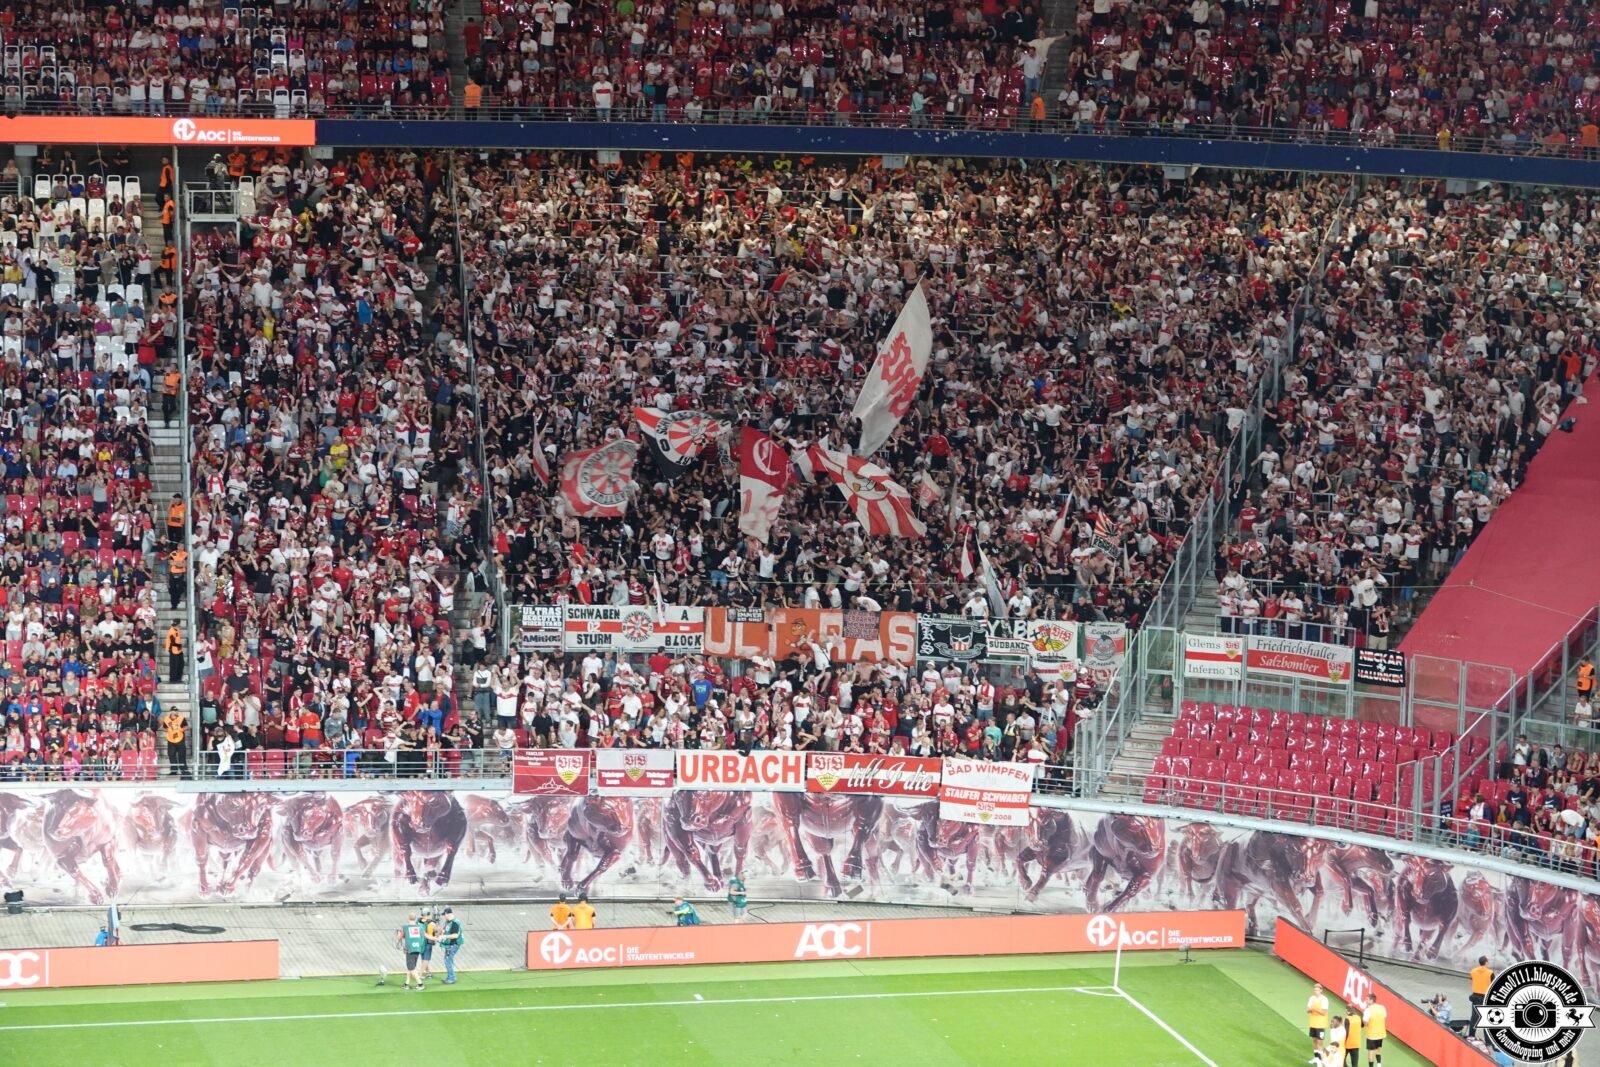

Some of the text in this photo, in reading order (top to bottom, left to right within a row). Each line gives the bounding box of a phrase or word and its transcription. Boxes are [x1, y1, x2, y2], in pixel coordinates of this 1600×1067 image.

[197, 130, 226, 141] AOC
[522, 606, 562, 616] ULTRAS
[568, 608, 689, 621] SCHWABEN A
[587, 622, 601, 632] 02
[576, 633, 702, 647] STURM BLOCK
[989, 640, 1030, 651] SÜDBANDE
[1188, 639, 1221, 649] Glems
[1256, 639, 1337, 661] Friedrichshaller
[1260, 655, 1320, 673] Salzbomber
[1359, 650, 1403, 666] NECKAR
[1188, 664, 1225, 674] Inferno
[1357, 669, 1404, 683] HALUNKEN
[680, 755, 801, 784] URBACH
[847, 757, 886, 788] till
[903, 763, 934, 792] die
[948, 764, 1030, 782] BAD WIMPFEN
[945, 789, 1028, 804] STAUFER SCHWABEN
[795, 923, 862, 957] AOC
[1168, 936, 1233, 944] STADTENTWICKLER
[575, 946, 639, 963] AOC DIE
[627, 952, 695, 961] STADTENTWICKLER
[1343, 966, 1369, 1010] AOC
